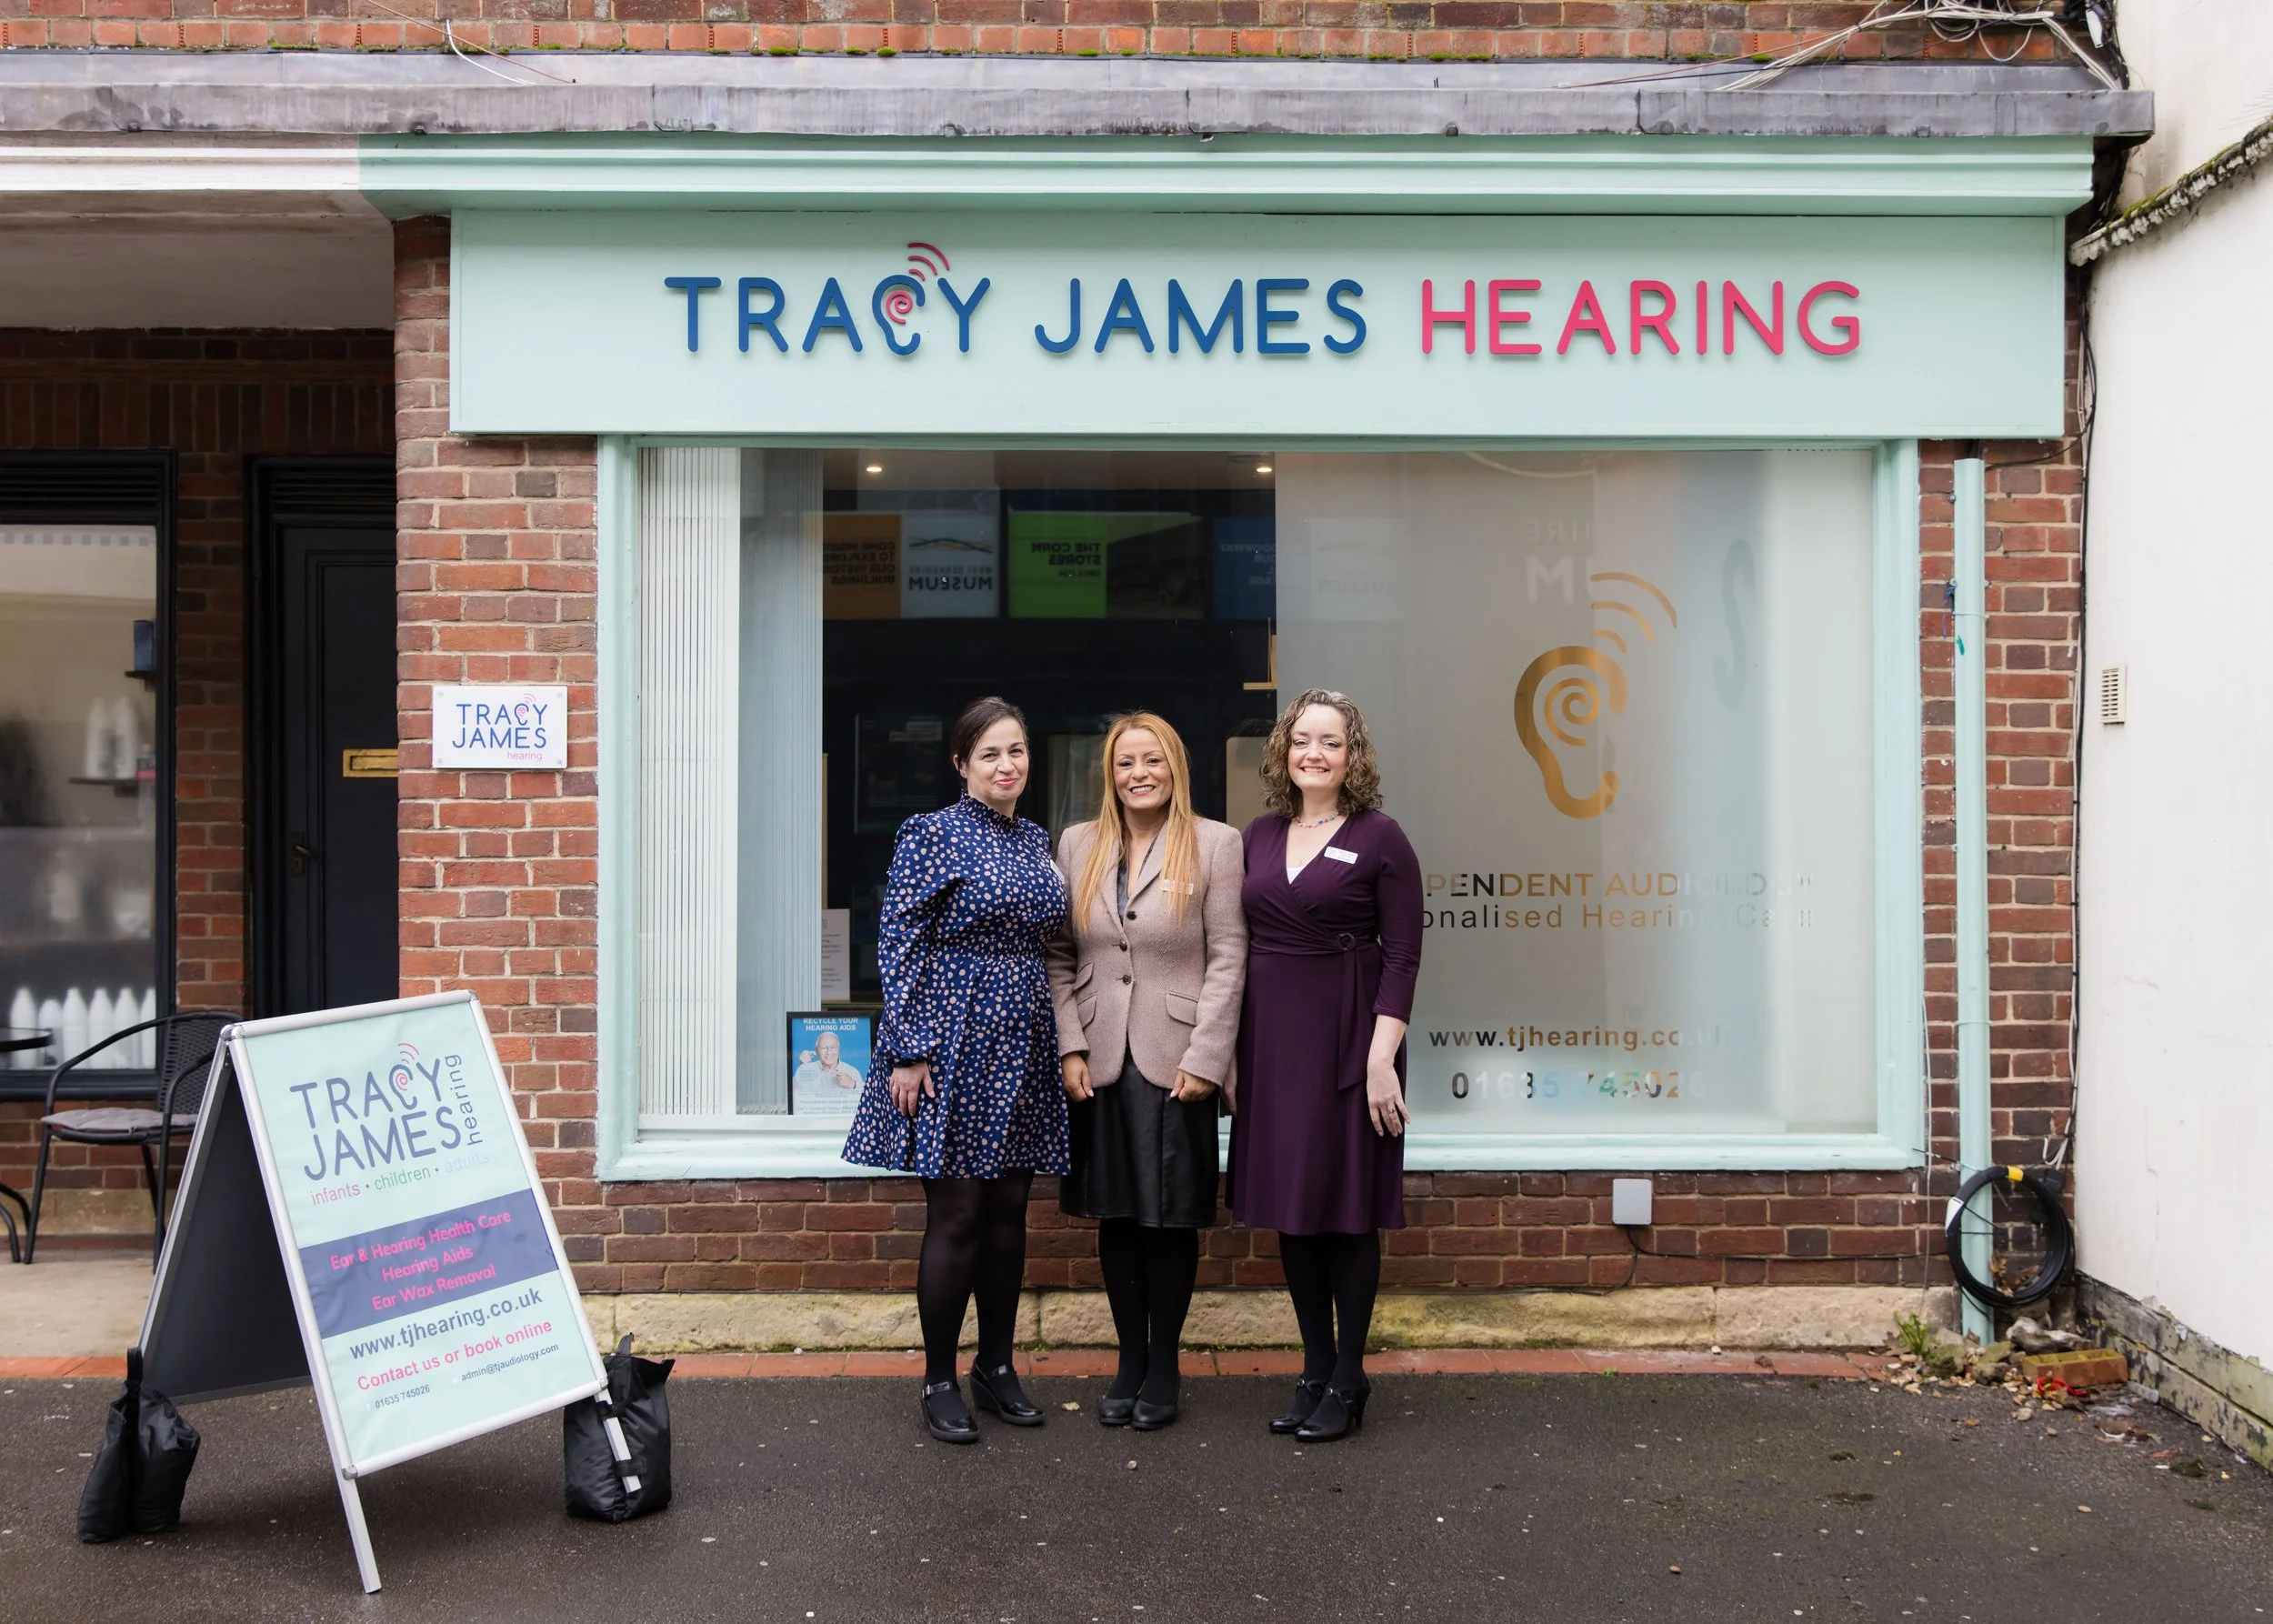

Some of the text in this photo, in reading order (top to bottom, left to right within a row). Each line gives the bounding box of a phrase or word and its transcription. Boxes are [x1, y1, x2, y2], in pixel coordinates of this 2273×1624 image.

[664, 275, 1860, 356] TRACY JAMES HEARING
[452, 727, 547, 748] JAMES
[456, 703, 548, 726] TRACY
[506, 751, 543, 762] hearing
[1423, 904, 1563, 928] onalised
[289, 1058, 441, 1129] TRACY
[445, 1054, 483, 1146] hearing
[1451, 1071, 1561, 1099] 01635
[305, 1106, 461, 1180] JAMES
[310, 1151, 490, 1206] infants children adults
[330, 1211, 512, 1270] Ear & Hearing Health Care
[382, 1247, 474, 1282] Hearing Aids
[372, 1263, 496, 1311] Ear Wax Removal
[350, 1288, 543, 1359] www.tjhearing.co.uk
[357, 1320, 553, 1390] Contact us or book online
[461, 1343, 559, 1382] admin@tjaudiology.com
[375, 1384, 431, 1409] 01635 745026
